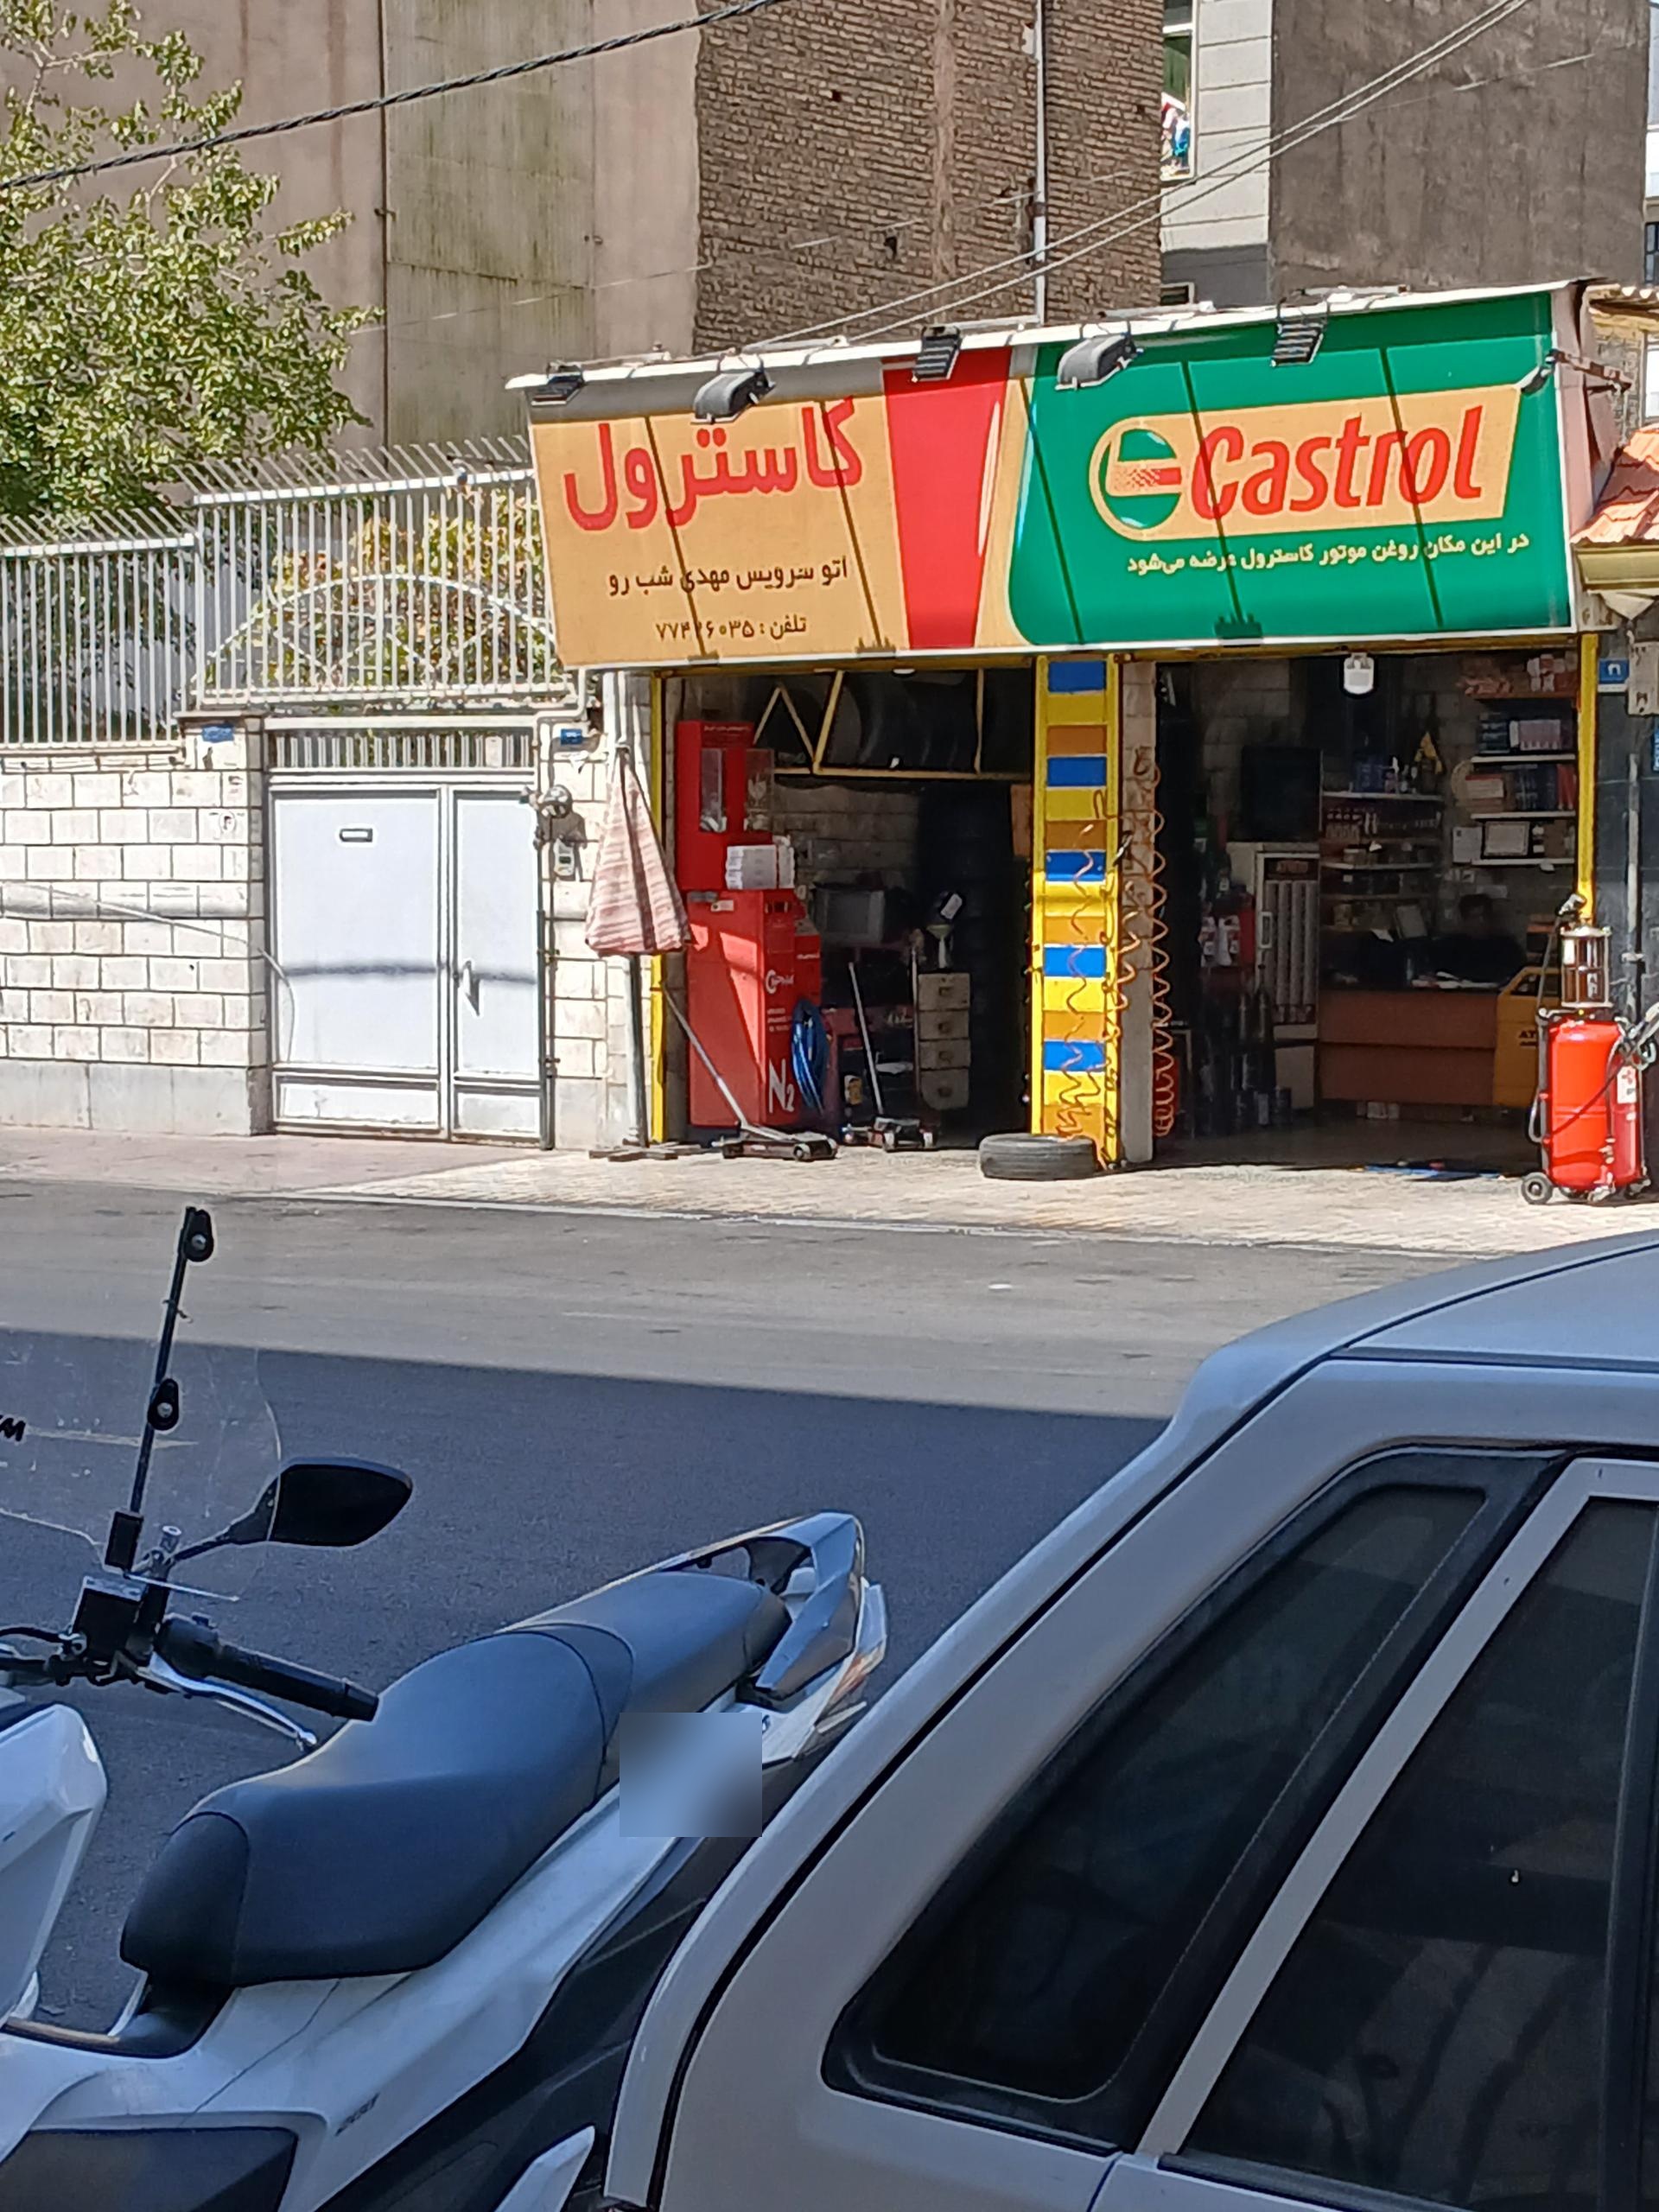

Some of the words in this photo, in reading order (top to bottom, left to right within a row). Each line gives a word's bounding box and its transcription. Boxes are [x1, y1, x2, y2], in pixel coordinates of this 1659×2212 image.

[563, 396, 863, 531] کاسترول
[1191, 405, 1483, 520] Castrol
[1241, 543, 1314, 569] کاسترول
[1319, 543, 1367, 566] موتور
[1371, 539, 1419, 562] روغن
[1424, 534, 1466, 560] مکان
[1471, 532, 1502, 556] این
[1507, 533, 1529, 554] در
[822, 556, 848, 586] اتو
[1189, 550, 1237, 572] عرضه
[681, 567, 730, 594] مهدی
[735, 566, 814, 590] سرویس
